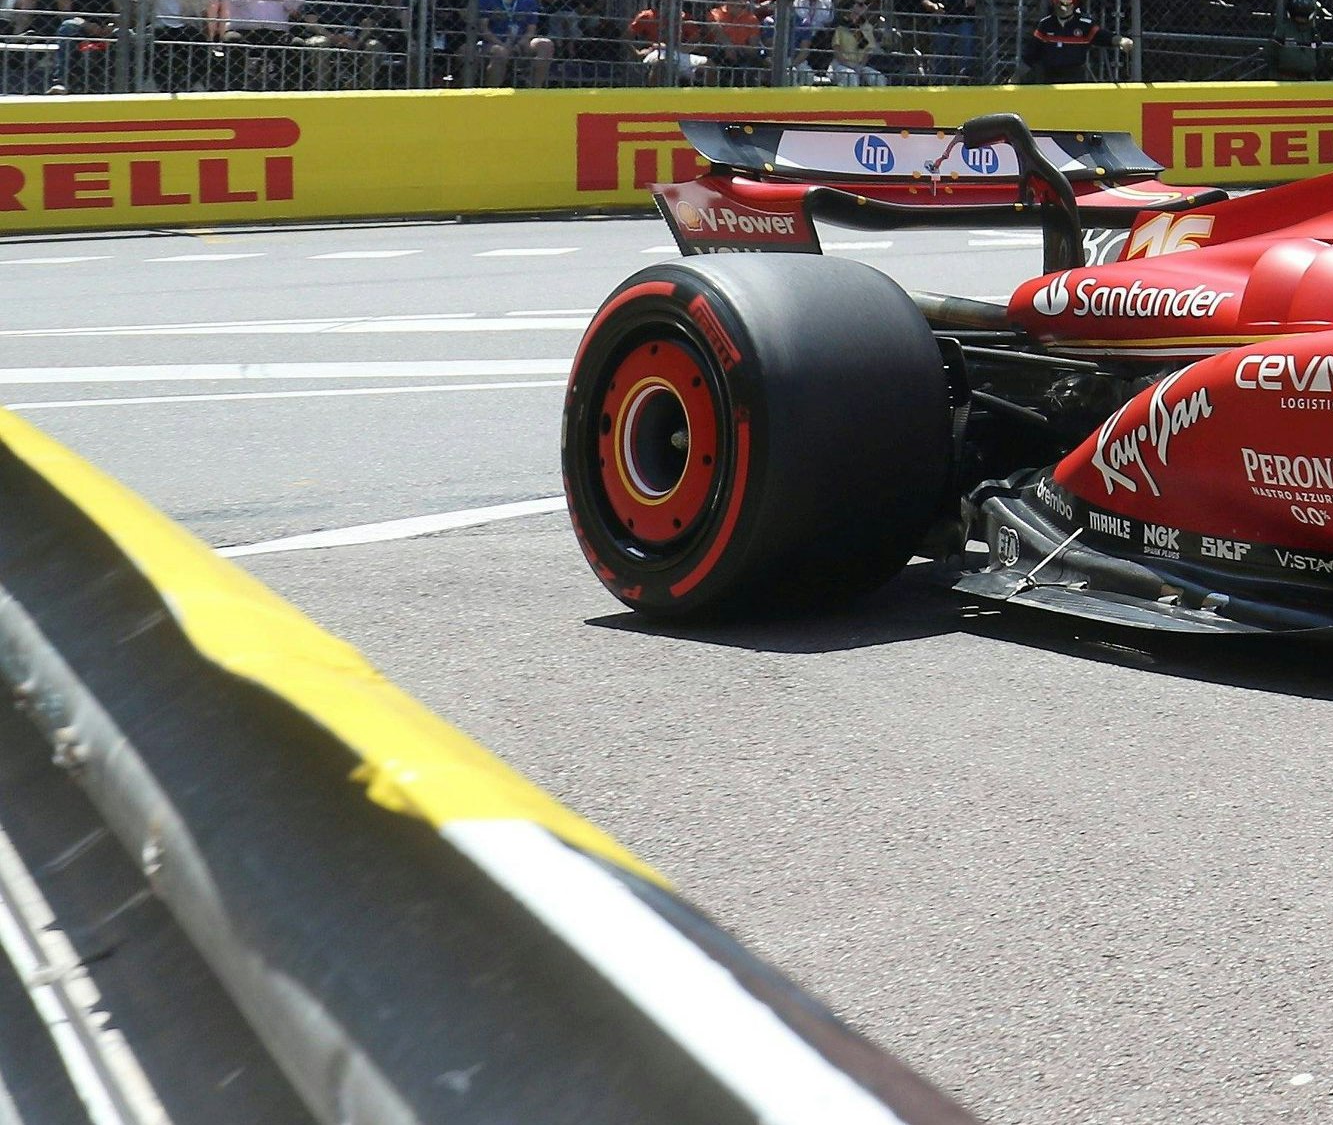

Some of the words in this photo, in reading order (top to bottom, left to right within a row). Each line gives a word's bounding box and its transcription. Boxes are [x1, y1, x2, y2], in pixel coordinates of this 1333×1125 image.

[862, 137, 890, 172] hp
[699, 207, 795, 235] V-Power
[1074, 278, 1235, 318] Santander
[1036, 476, 1073, 521] brembo
[1251, 485, 1293, 501] NASTRO
[1088, 510, 1131, 540] MAHLE
[1143, 523, 1180, 551] NGK
[1201, 536, 1252, 562] SKF
